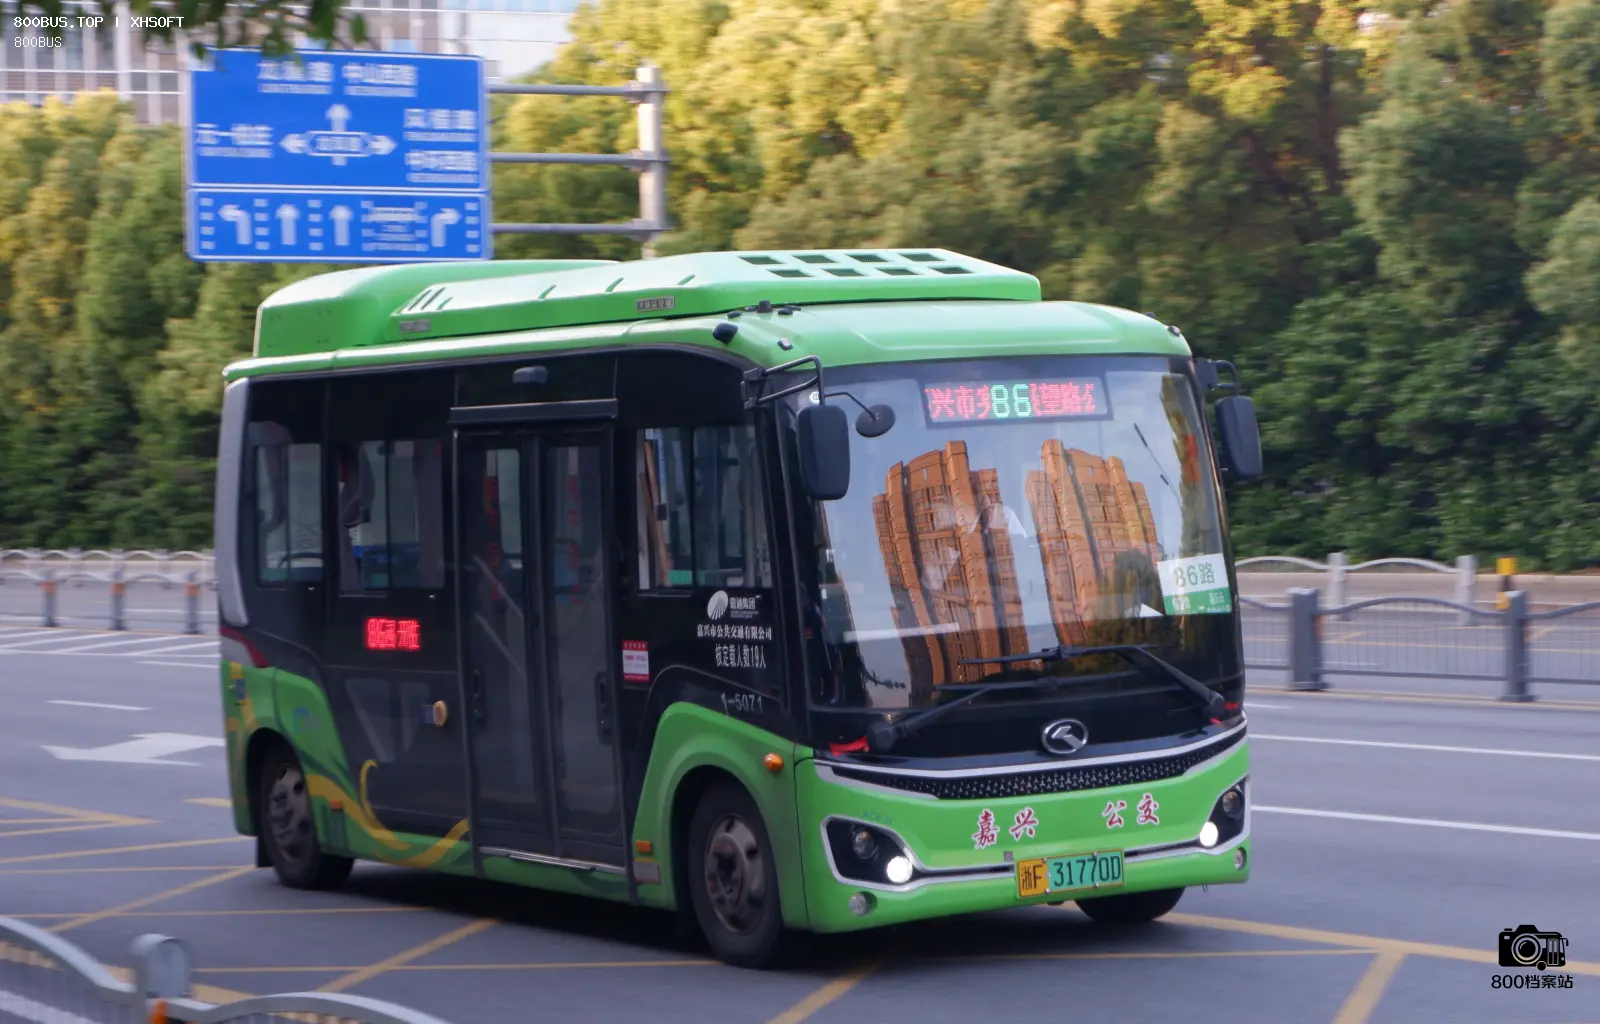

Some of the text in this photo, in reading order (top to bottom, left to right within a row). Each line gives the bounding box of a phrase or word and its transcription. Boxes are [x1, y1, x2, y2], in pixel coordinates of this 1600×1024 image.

[990, 384, 1032, 418] 86
[1173, 562, 1215, 587] 86路
[696, 624, 772, 641] 嘉兴市公共交通有限公司
[715, 643, 767, 669] 核定载人数19人
[971, 792, 1160, 849] 嘉兴 公交
[1021, 855, 1122, 891] 浙F 31770D
